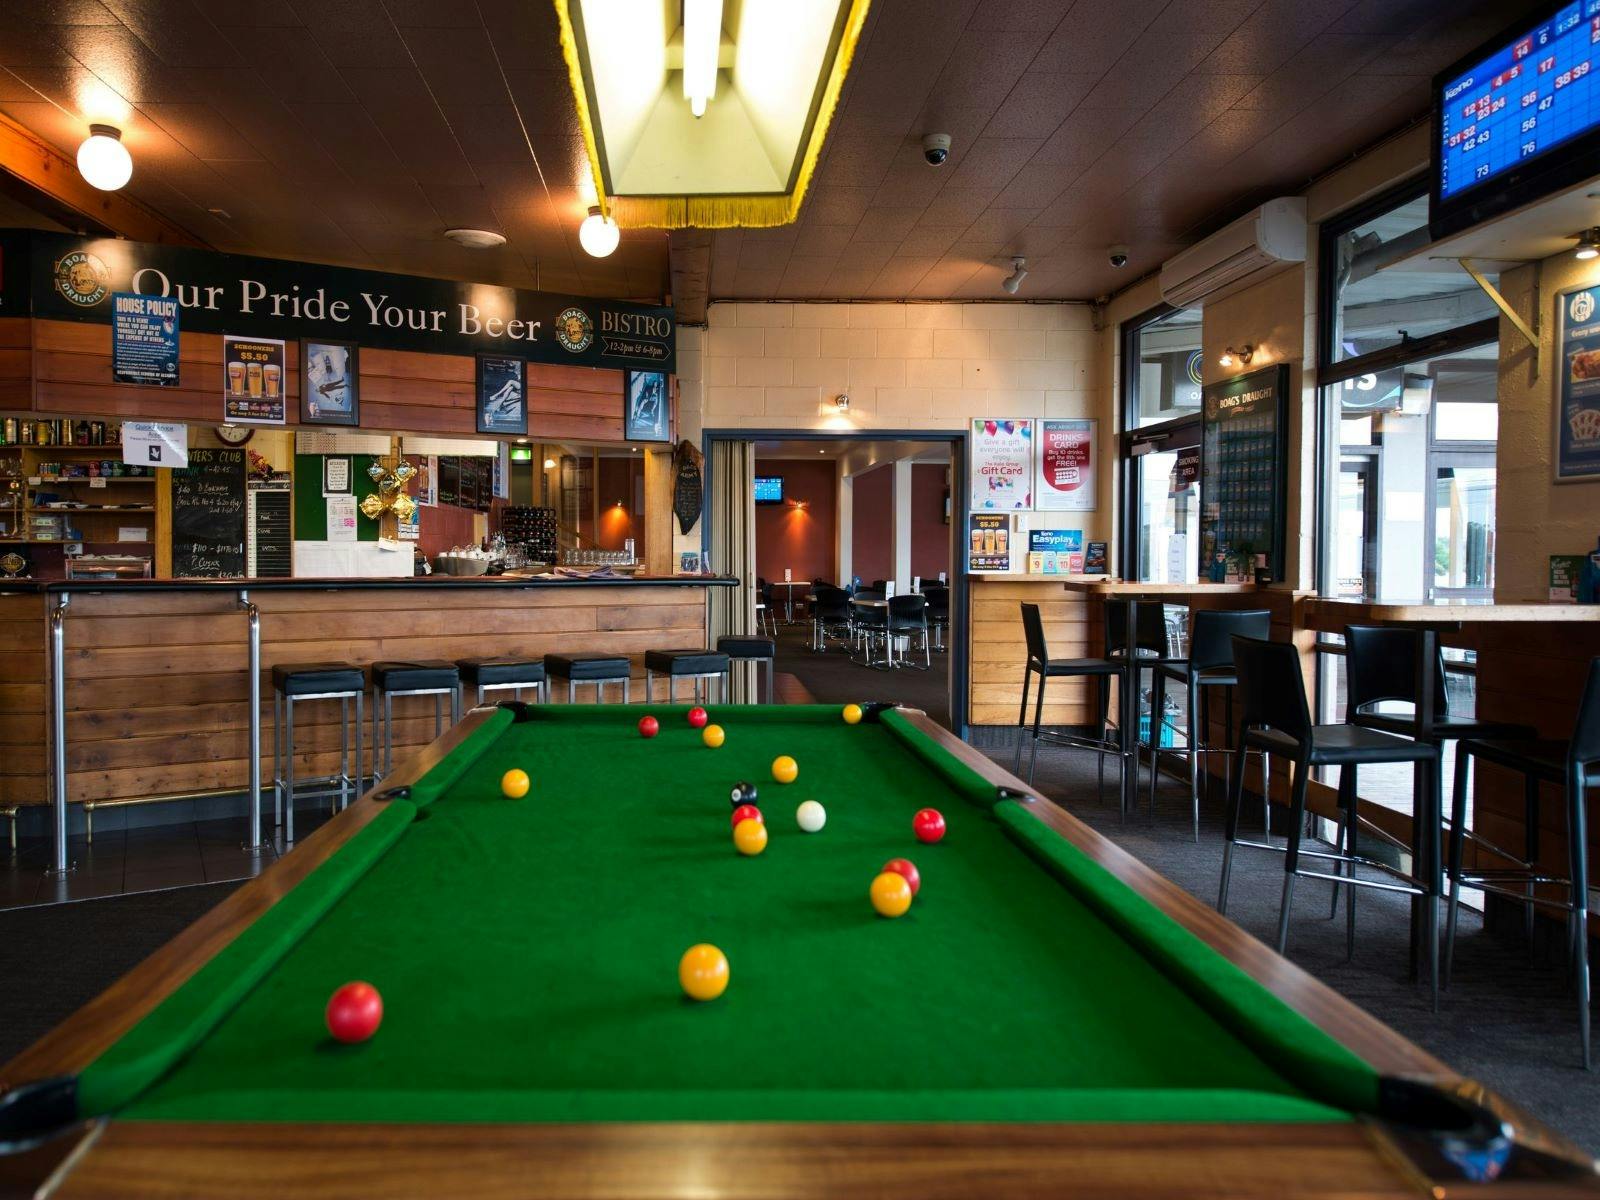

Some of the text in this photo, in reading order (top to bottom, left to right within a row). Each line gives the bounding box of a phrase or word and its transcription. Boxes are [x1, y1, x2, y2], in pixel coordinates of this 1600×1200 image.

[1558, 14, 1580, 32] 1:32
[1540, 34, 1547, 44] 6
[1517, 45, 1528, 58] 14
[1495, 78, 1503, 86] 4
[1510, 66, 1518, 78] 5
[1464, 102, 1476, 117] 12
[1478, 94, 1490, 108] 13
[1540, 57, 1553, 73] 17
[1449, 62, 1590, 147] 31 32 36 38 39
[1477, 97, 1506, 120] 23 24
[1463, 96, 1553, 152] 42 43 47
[1522, 117, 1536, 133] 56
[1477, 141, 1536, 178] 73 76
[62, 283, 105, 302] DRAUGHT
[116, 297, 177, 316] HOUSE POLICY
[132, 268, 541, 342] Our Pride Your Beer
[562, 311, 586, 323] BOAG'S
[602, 311, 671, 338] BISTRO
[234, 344, 274, 352] SCHOONERS
[560, 334, 590, 350] DRAUGHT
[610, 342, 663, 357] 12-2pm & 6-8pm
[240, 352, 268, 361] $5.50
[1220, 387, 1273, 409] BOAG'S DRAUGHT
[188, 451, 241, 462] NTERS CLUB
[1178, 456, 1199, 467] SMOKING
[981, 466, 1022, 475] Gift Card
[1182, 467, 1196, 476] AREA
[1032, 535, 1073, 544] Easyplay
